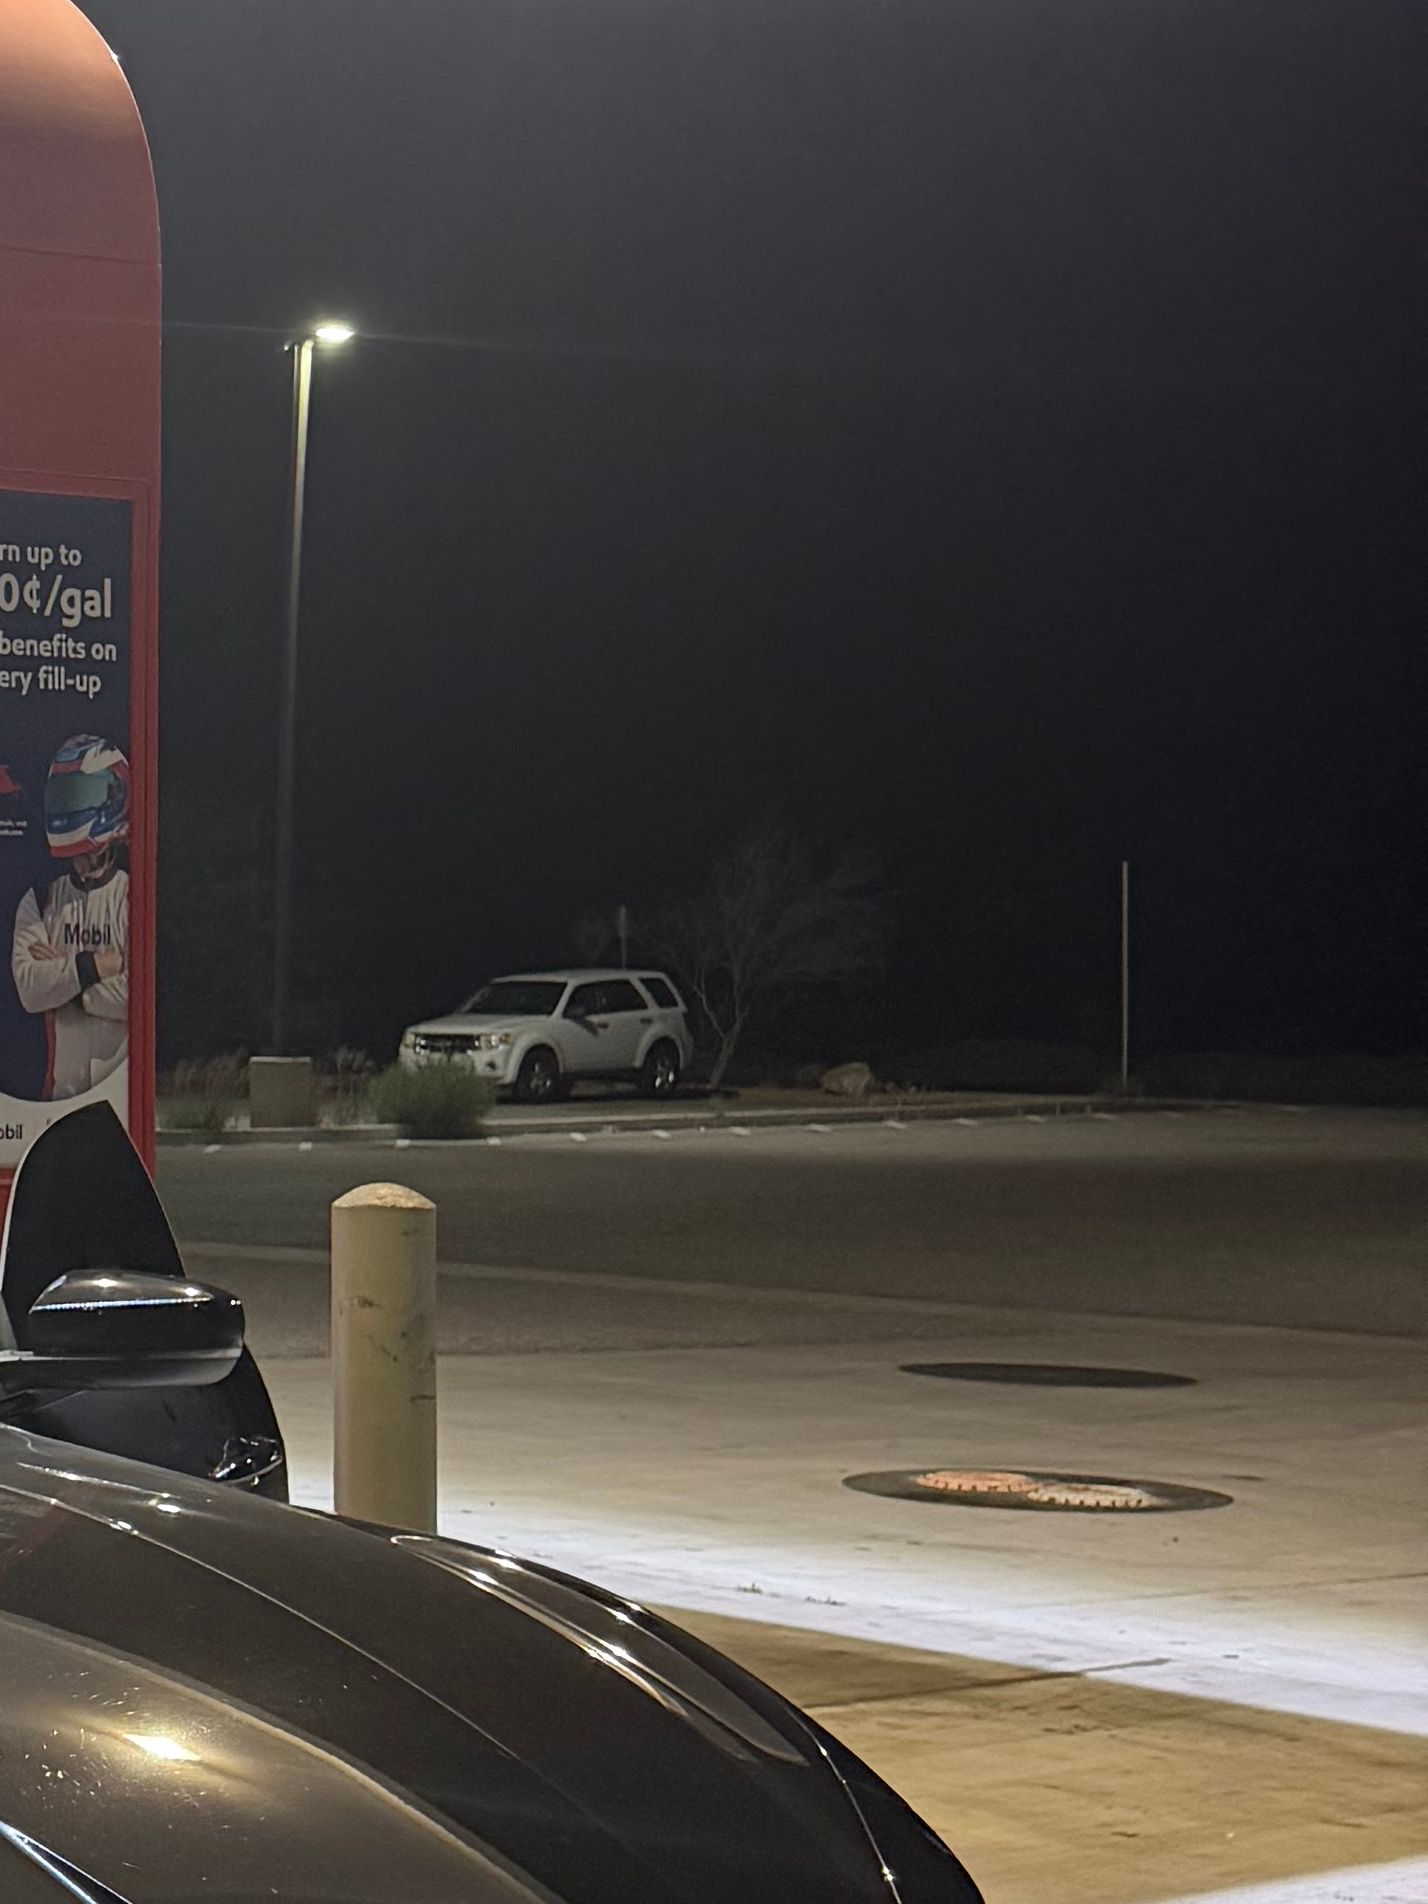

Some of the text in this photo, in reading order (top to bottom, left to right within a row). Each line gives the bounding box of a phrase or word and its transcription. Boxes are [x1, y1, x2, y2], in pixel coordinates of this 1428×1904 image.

[26, 545, 54, 571] up
[58, 544, 82, 567] to
[90, 642, 117, 662] on
[38, 664, 102, 699] fill-up
[64, 923, 111, 946] Mobil
